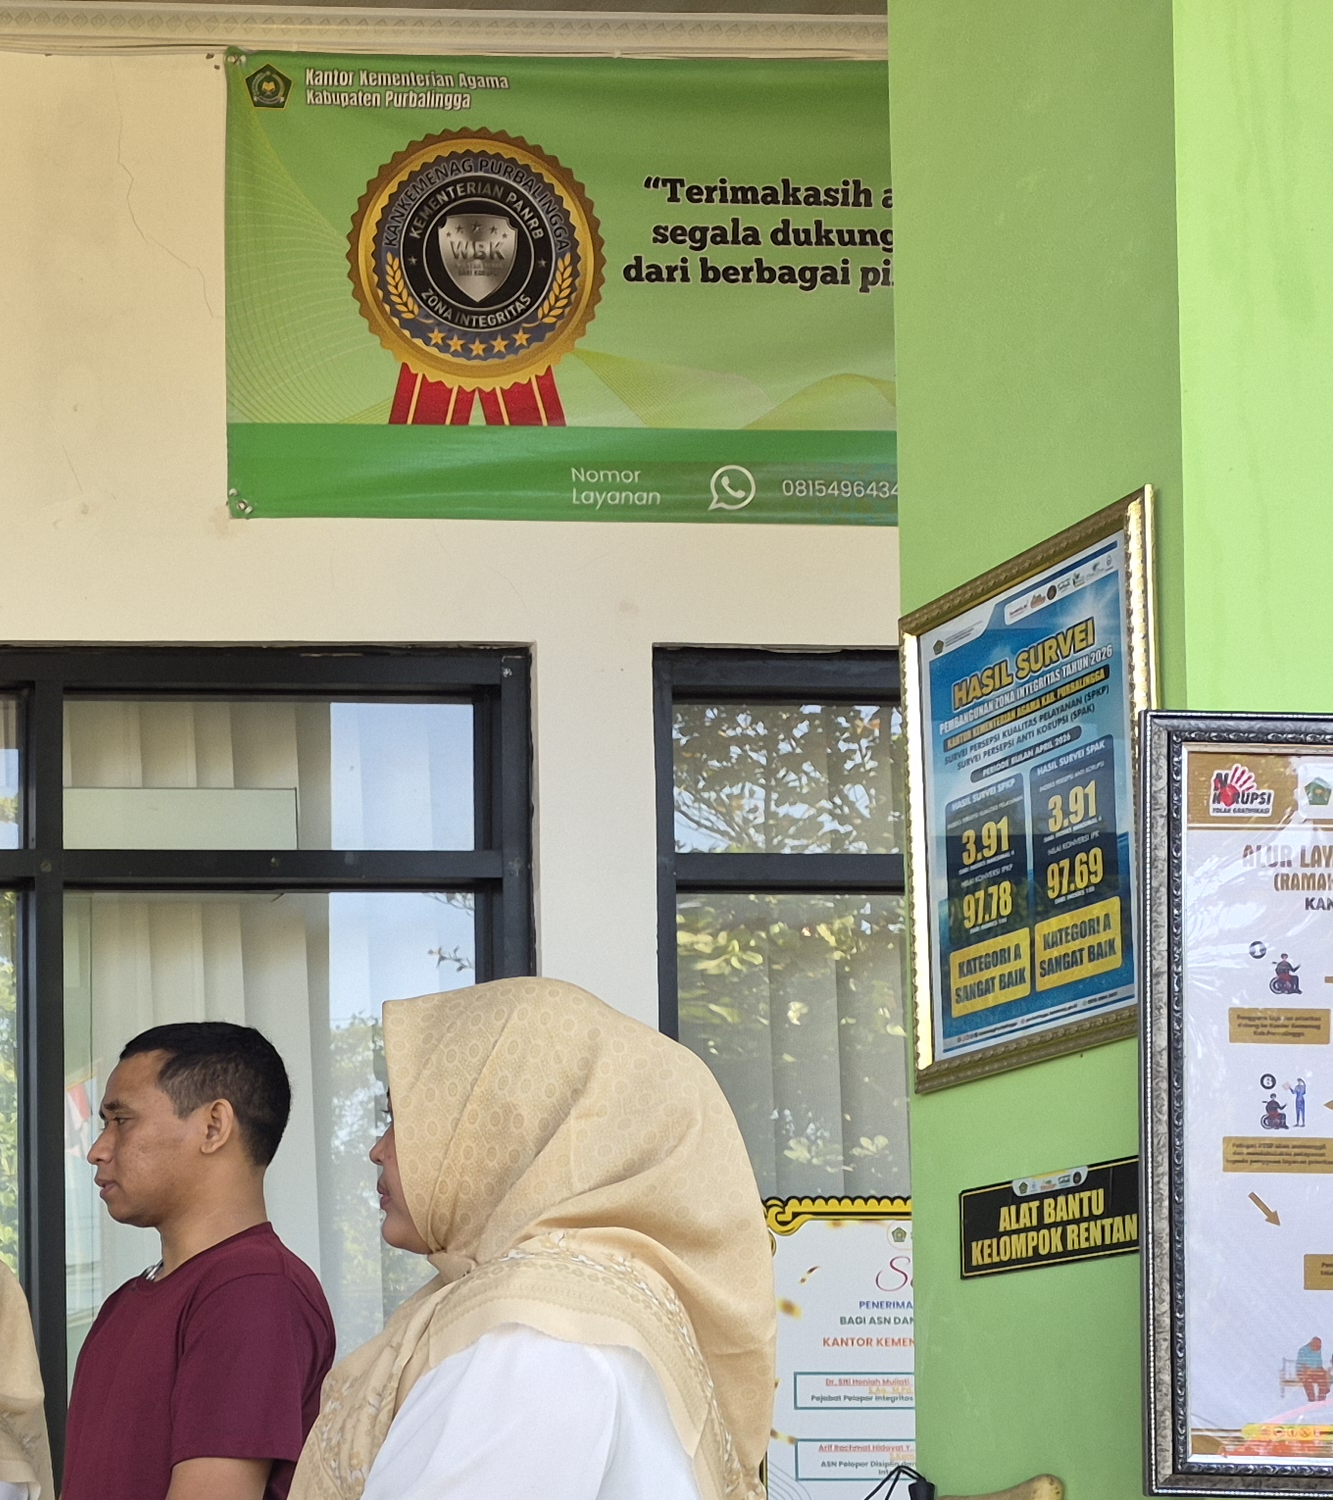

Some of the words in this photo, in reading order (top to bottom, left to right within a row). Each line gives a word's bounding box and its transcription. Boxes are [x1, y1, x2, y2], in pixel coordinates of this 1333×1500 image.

[305, 68, 354, 87] Kantor
[360, 69, 455, 88] Kementerian
[459, 73, 510, 90] Agama
[306, 88, 381, 108] Kabupaten
[385, 89, 471, 111] Purbalingga
[383, 157, 474, 249] KANKEMENAG
[478, 158, 572, 251] PURBALINGGA
[409, 181, 504, 240] KEMENTERIAN
[506, 191, 545, 240] PANRB
[449, 240, 506, 261] WBK
[652, 217, 762, 252] segala
[622, 255, 691, 283] dari
[699, 256, 851, 292] berbagai
[859, 258, 894, 293] pi
[421, 288, 453, 322] ZONA
[455, 294, 532, 328] INTEGRITAS
[571, 467, 641, 483] Nomor
[572, 487, 661, 511] Layanan
[951, 658, 1015, 712] HASIL
[1014, 616, 1095, 680] SURVEI
[1089, 644, 1113, 667] 2026
[1016, 730, 1035, 746] ANTI
[1070, 703, 1095, 724] (SPAK)
[1047, 778, 1098, 834] 3.91
[961, 814, 1011, 867] 3.91
[1046, 846, 1104, 900] 97.69
[962, 879, 1014, 929] 97.78
[1042, 916, 1101, 952] KATEGORI
[1102, 912, 1112, 932] A
[957, 946, 1012, 980] KATEGORI
[1013, 943, 1022, 962] A
[1039, 948, 1086, 978] SANGAT
[1087, 937, 1117, 963] BAIK
[954, 976, 997, 1005] SANGAT
[998, 966, 1027, 991] BAIK
[998, 1200, 1041, 1233] ALAT
[1043, 1188, 1105, 1225] BANTU
[970, 1226, 1064, 1267] KELOMPOK
[1066, 1213, 1139, 1251] RENTAN
[839, 1316, 867, 1326] BAGI
[869, 1316, 892, 1326] ASN
[859, 1299, 914, 1311] PENERIMA
[822, 1336, 873, 1348] KANTOR
